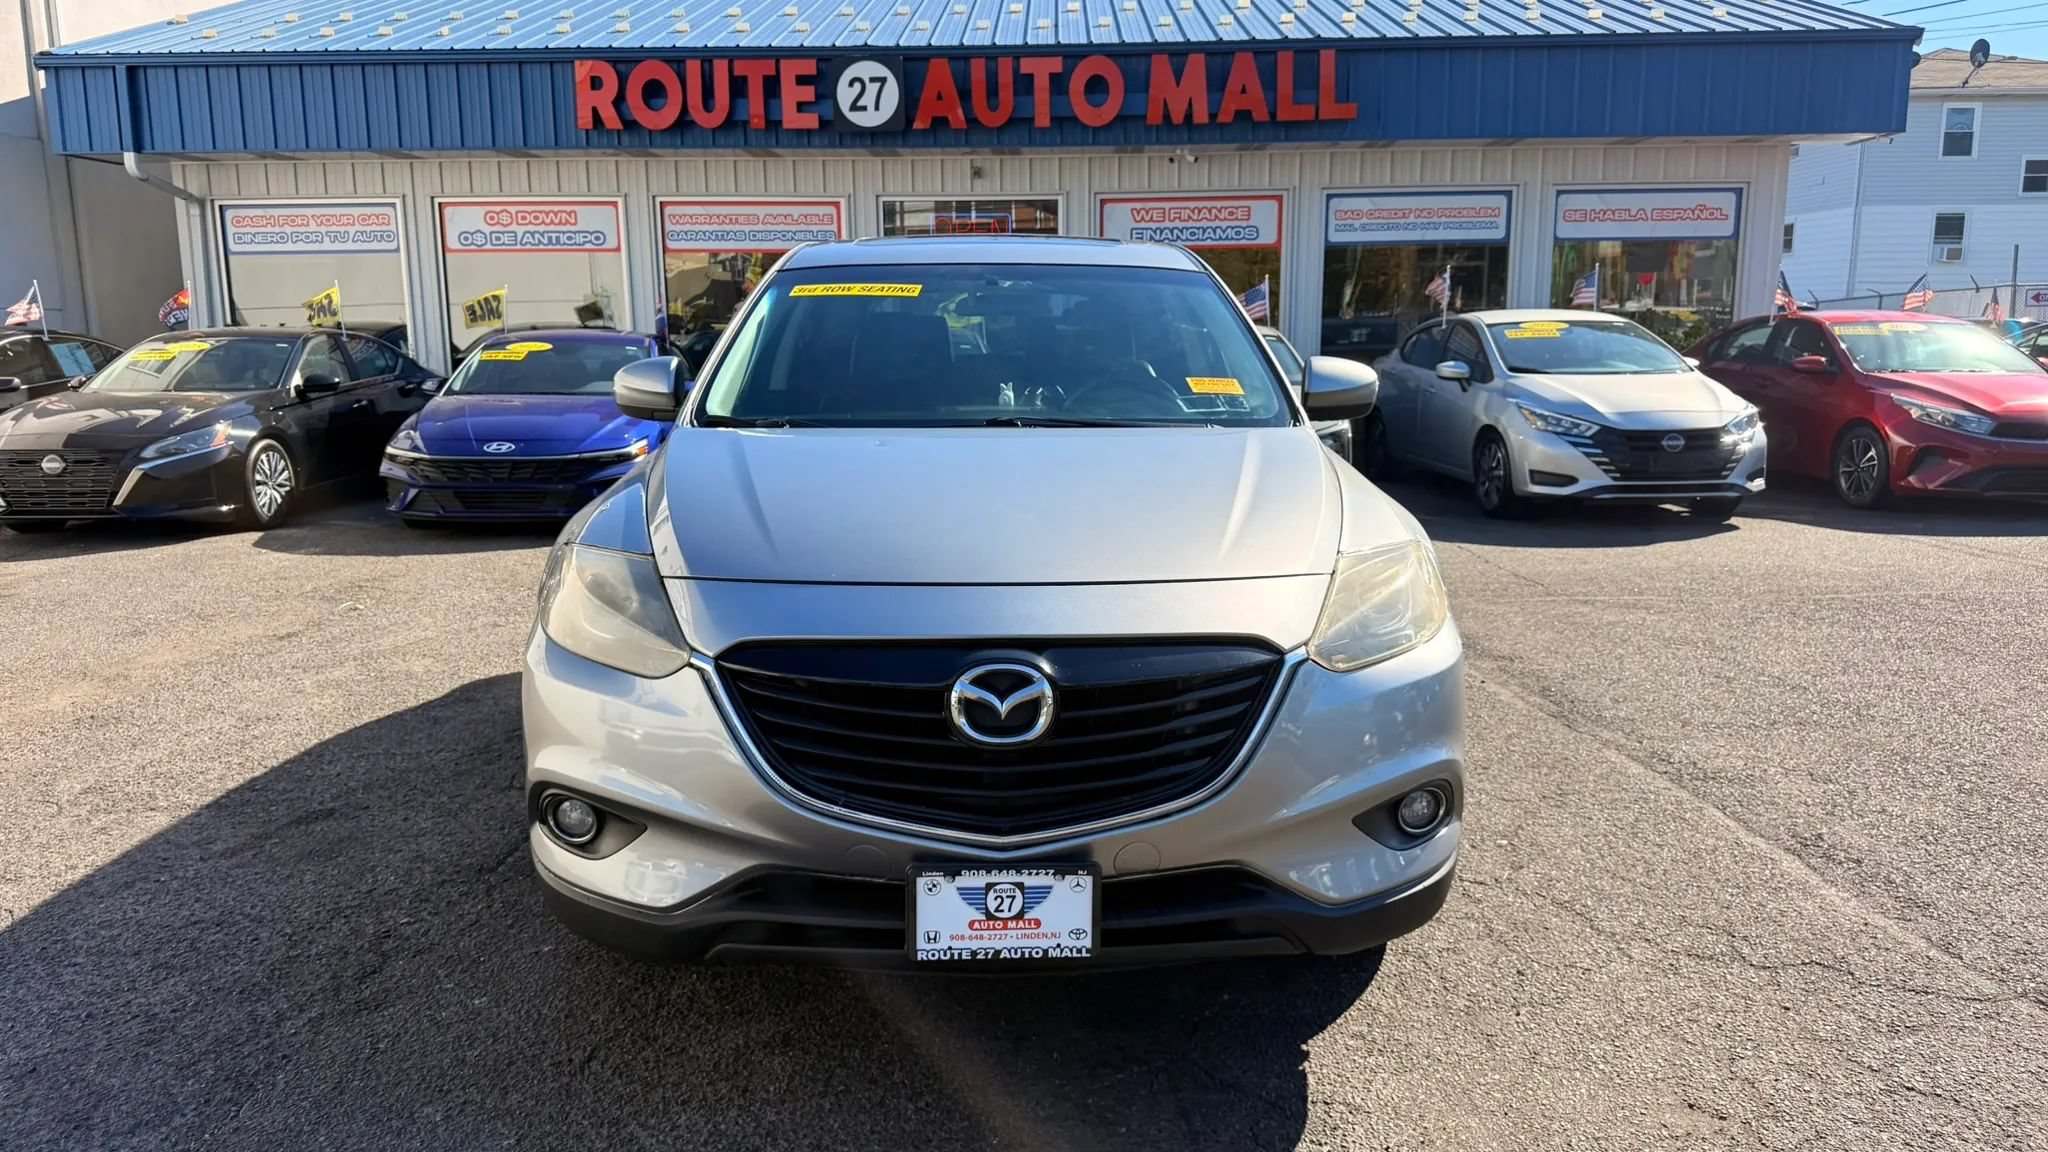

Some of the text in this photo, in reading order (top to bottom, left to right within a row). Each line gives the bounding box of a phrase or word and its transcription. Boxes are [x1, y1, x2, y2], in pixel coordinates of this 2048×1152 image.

[575, 49, 1358, 131] ROUTE 27 AUTO MALL
[516, 210, 577, 226] DOWN
[669, 214, 834, 226] WARRANTIES AVAILABLE
[1131, 206, 1251, 222] WE FINANCE
[1335, 207, 1500, 220] BAD CREDIT NO PROBLEM
[1563, 204, 1728, 222] SE HABLA ESPAÑOL
[232, 213, 389, 228] CASH FOR YOUR CAR
[934, 217, 1009, 236] OPEN
[1359, 222, 1401, 232] CREDITO
[1402, 222, 1418, 231] NO
[1442, 221, 1499, 230] PROBLEMA
[233, 230, 394, 244] DINERO POR TU AUTO
[490, 231, 517, 246] DE
[520, 231, 606, 246] ANTICIPO
[667, 230, 836, 242] GARANTIAS DISPONIBLES
[1130, 226, 1259, 242] FINANCIAMOS
[961, 869, 1055, 877] 908-648-2727
[994, 895, 1016, 912] 27
[973, 920, 1038, 929] AUTO MALL
[950, 933, 1008, 941] 908-648-2727
[917, 947, 1091, 960] ROUTE 27 AUTO MALL
